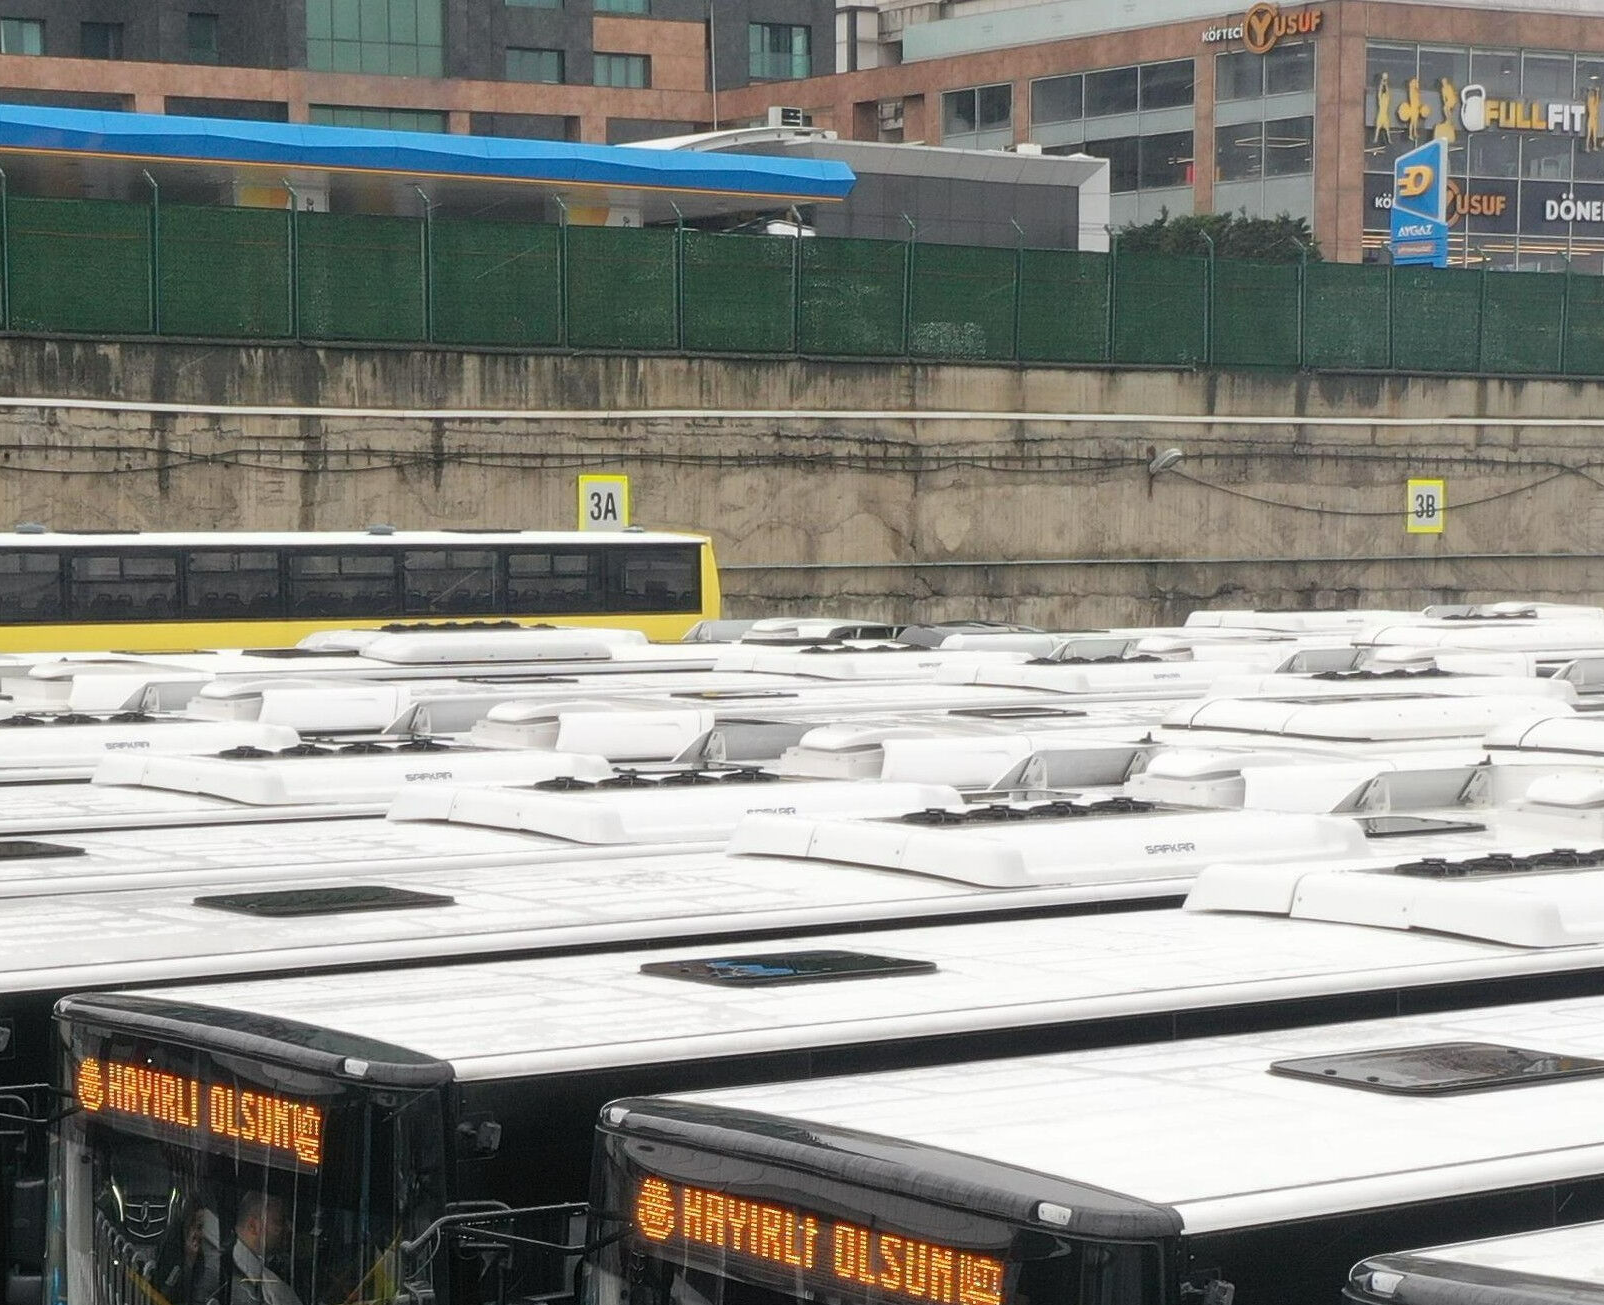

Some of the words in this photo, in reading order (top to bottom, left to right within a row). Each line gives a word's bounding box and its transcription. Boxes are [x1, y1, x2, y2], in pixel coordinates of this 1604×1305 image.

[1249, 10, 1323, 48] YUSUF
[1447, 190, 1507, 216] USUF
[1398, 224, 1433, 238] AYGAZ
[590, 491, 618, 521] 3A
[1415, 493, 1436, 519] 3B
[108, 1062, 198, 1128] HAYIRLI
[210, 1085, 289, 1149] OLSUN
[834, 1224, 953, 1303] OLSUN
